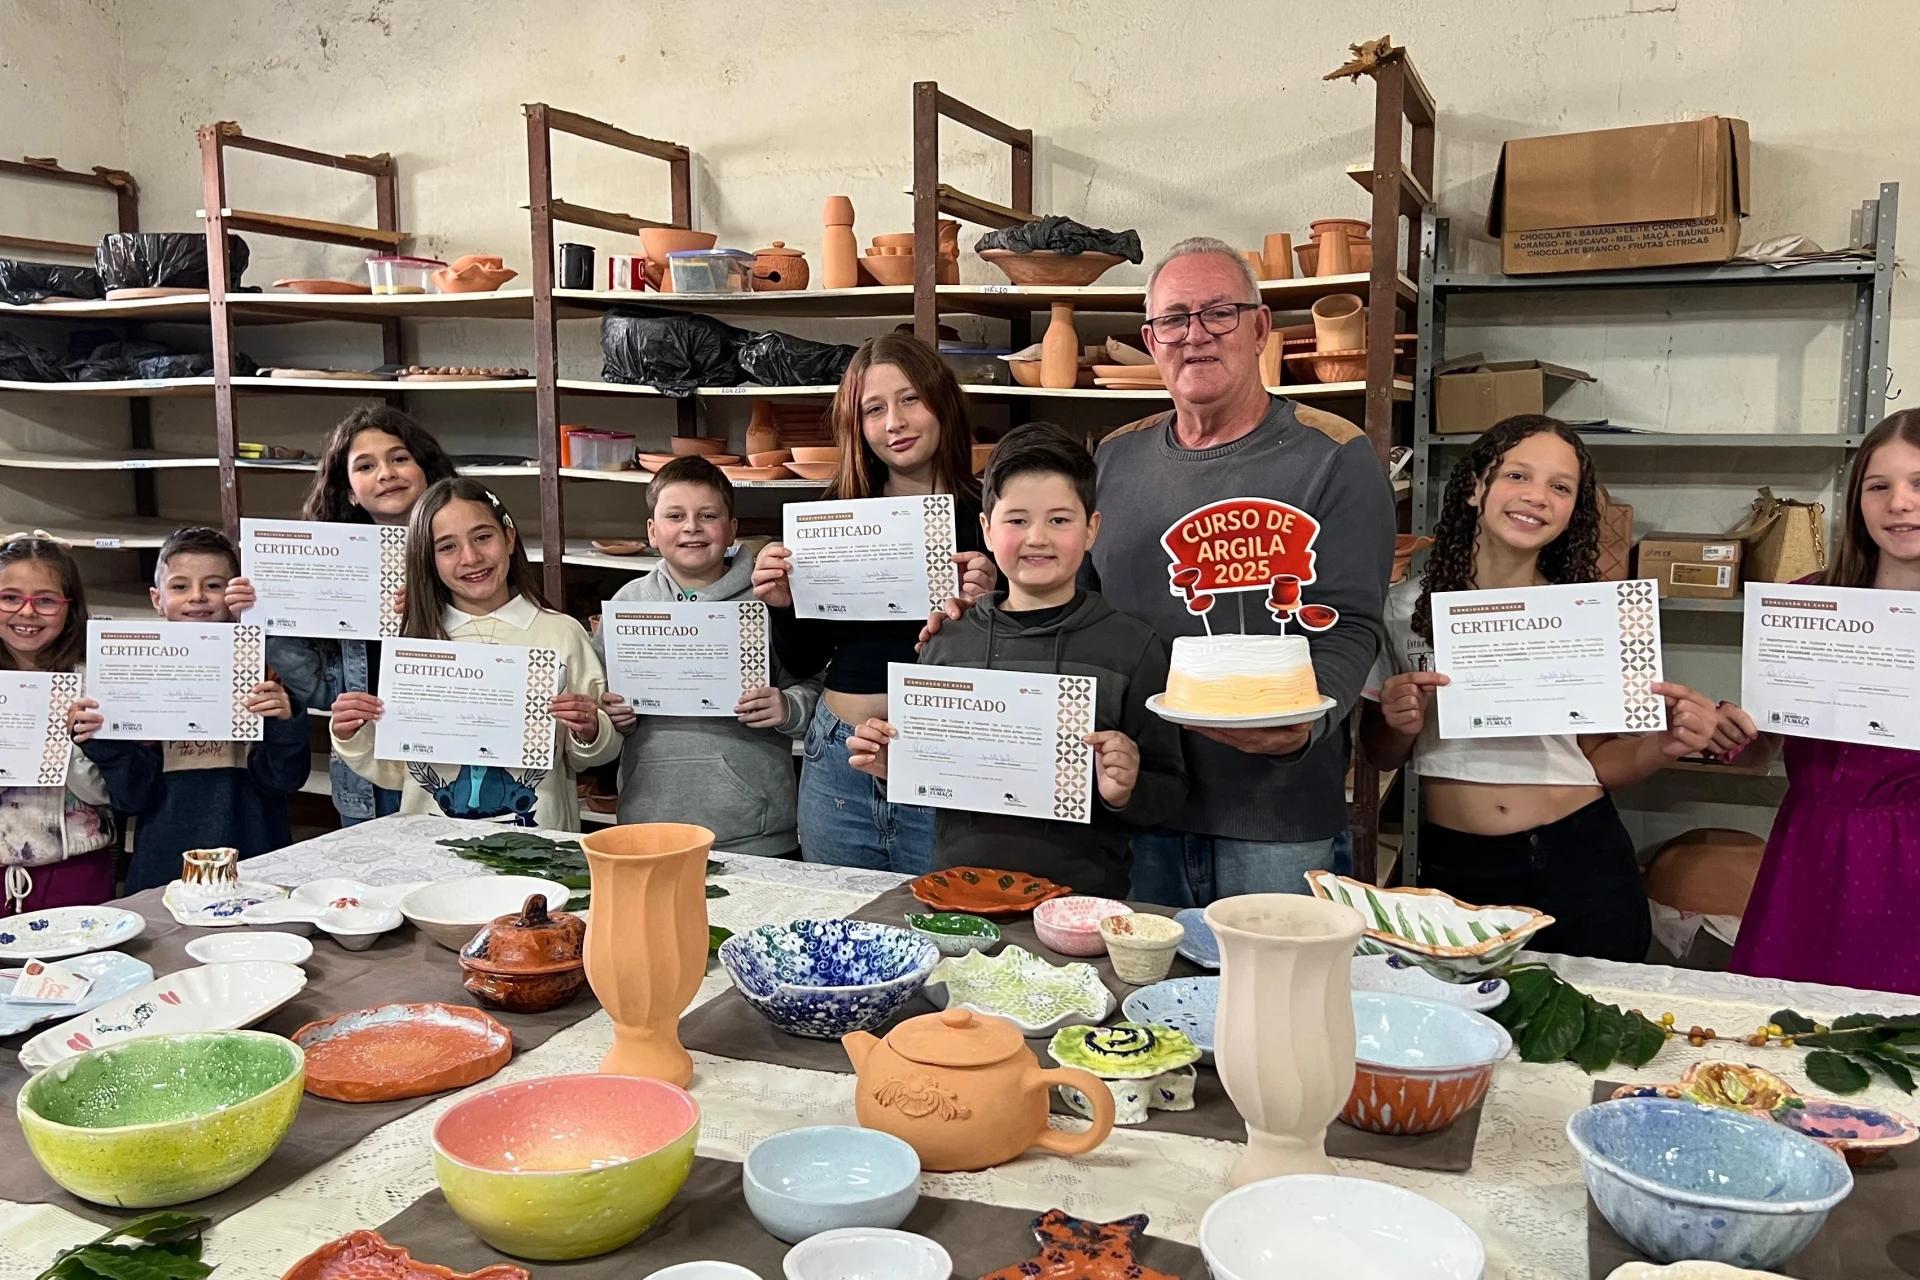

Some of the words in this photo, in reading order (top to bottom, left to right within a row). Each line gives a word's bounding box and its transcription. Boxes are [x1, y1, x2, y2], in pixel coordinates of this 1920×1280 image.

[1513, 240, 1557, 249] MORANGO
[1565, 237, 1609, 246] MASCAVO
[1616, 234, 1634, 242] MEL
[1642, 229, 1670, 241] MAÇÃ
[1677, 226, 1726, 238] BAUNILHA
[1520, 231, 1573, 241] CHOCOLATE
[1579, 228, 1617, 237] BANANA
[1624, 224, 1649, 233] LEITE
[1652, 218, 1718, 231] CONDENSADO
[1527, 247, 1580, 257] CHOCOLATE
[1582, 244, 1620, 253] BRANCO
[1628, 240, 1663, 250] FRUTAS
[796, 524, 882, 539] CERTIFICADO
[1182, 509, 1260, 544] CURSO
[1266, 510, 1297, 534] DE
[254, 544, 340, 556] CERTIFICADO
[1197, 534, 1286, 563] ARGILA
[1214, 560, 1271, 584] 2025
[616, 625, 699, 636] CERTIFICADO
[1450, 616, 1562, 635] CERTIFICADO
[1761, 614, 1874, 634] CERTIFICADO
[100, 646, 190, 657] CERTIFICADO
[394, 664, 484, 680] CERTIFICADO
[904, 693, 1006, 714] CERTIFICADO
